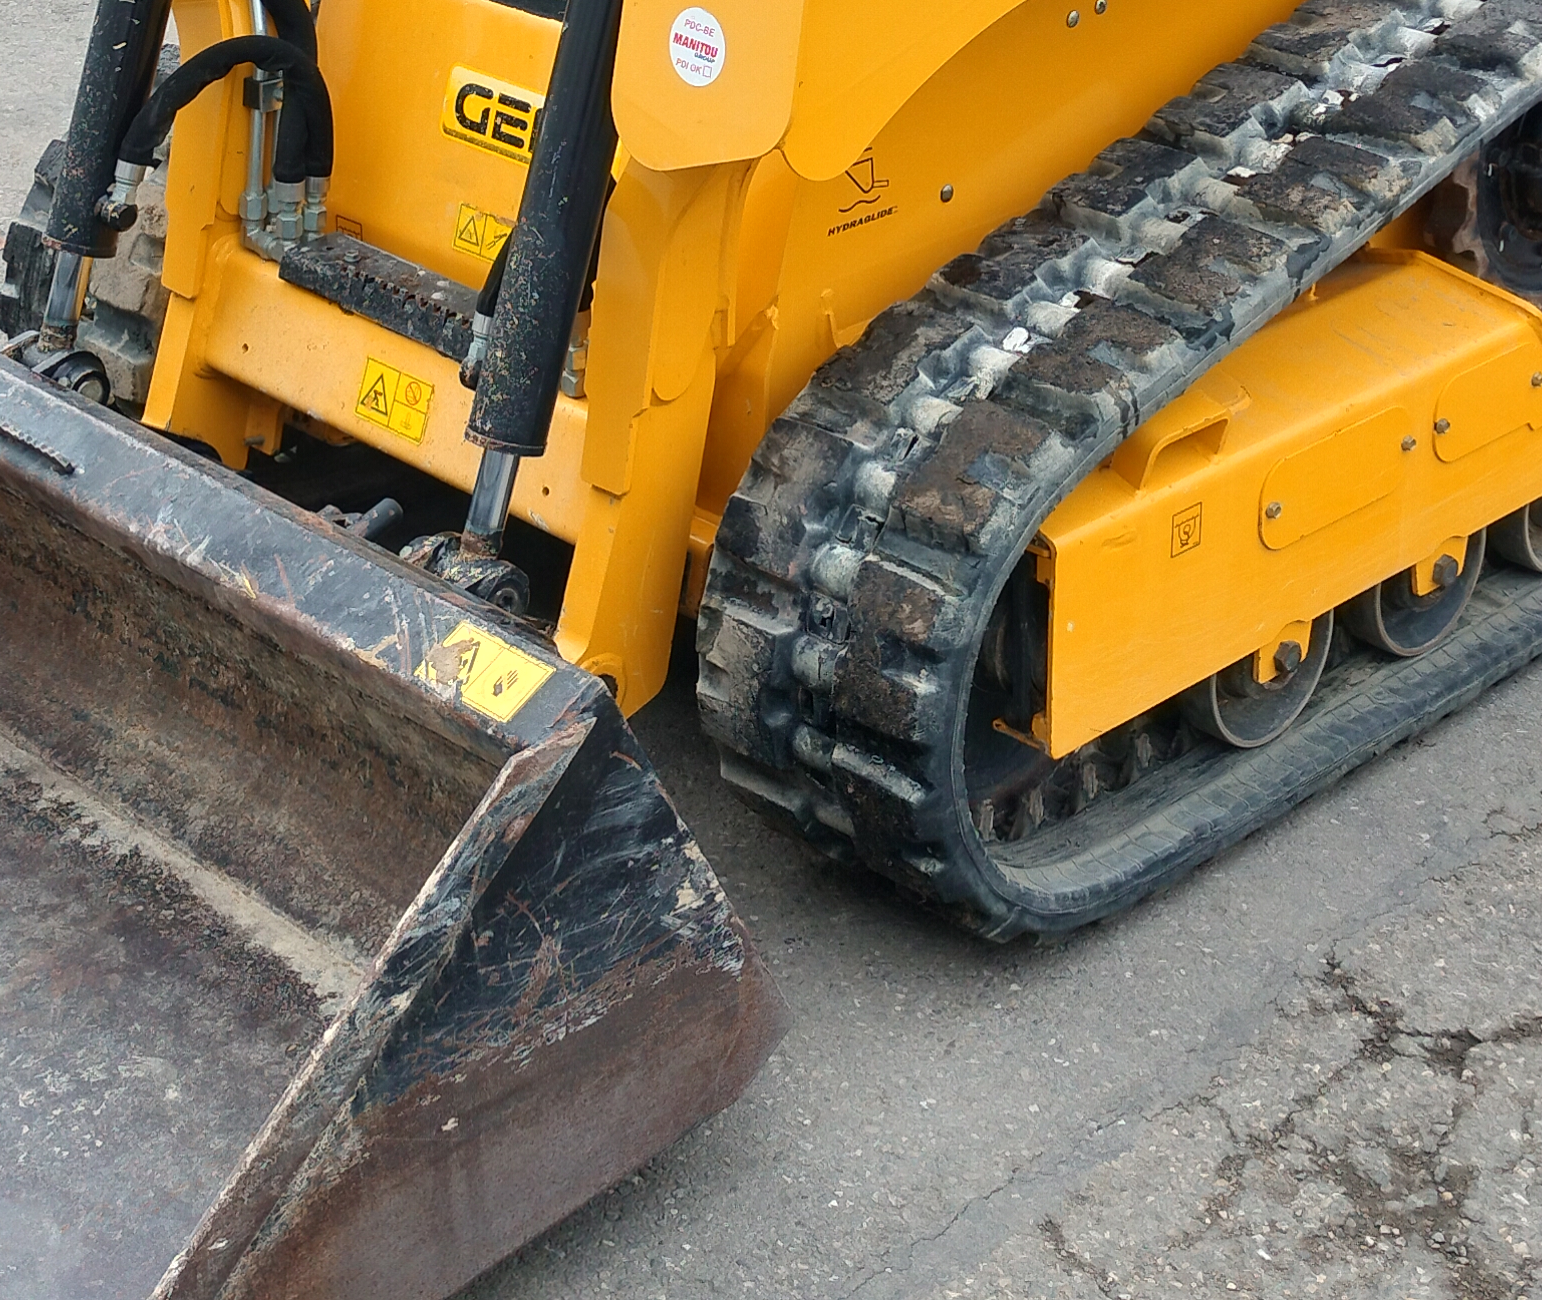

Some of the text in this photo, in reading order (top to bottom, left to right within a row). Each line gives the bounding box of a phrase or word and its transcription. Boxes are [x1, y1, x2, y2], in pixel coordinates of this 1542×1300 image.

[672, 32, 719, 58] MANITOU
[690, 63, 703, 75] OK
[454, 82, 544, 154] GE
